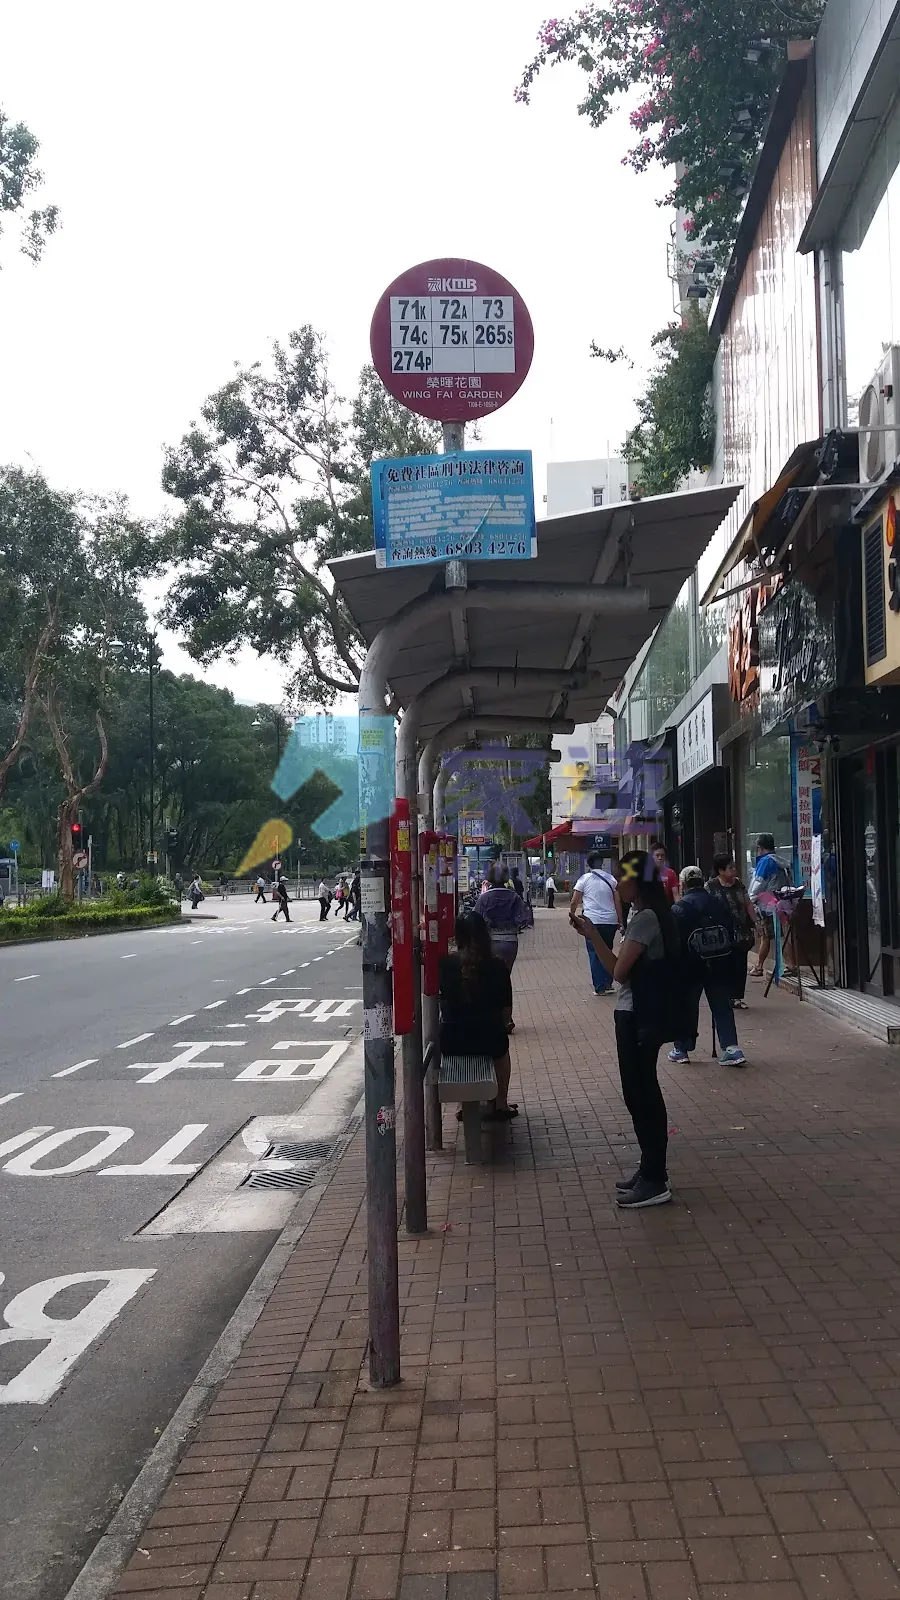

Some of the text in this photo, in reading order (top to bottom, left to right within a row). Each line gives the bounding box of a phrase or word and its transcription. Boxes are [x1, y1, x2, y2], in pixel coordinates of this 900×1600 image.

[398, 299, 505, 320] 71K 72A 73
[399, 324, 513, 345] 74C 75K 265S
[393, 350, 432, 371] 274P
[426, 376, 482, 389] 榮暉花園
[402, 390, 503, 399] WING FAI GARDEN
[445, 541, 483, 556] 6803
[487, 541, 526, 555] 4276
[127, 1040, 353, 1084] 巴士
